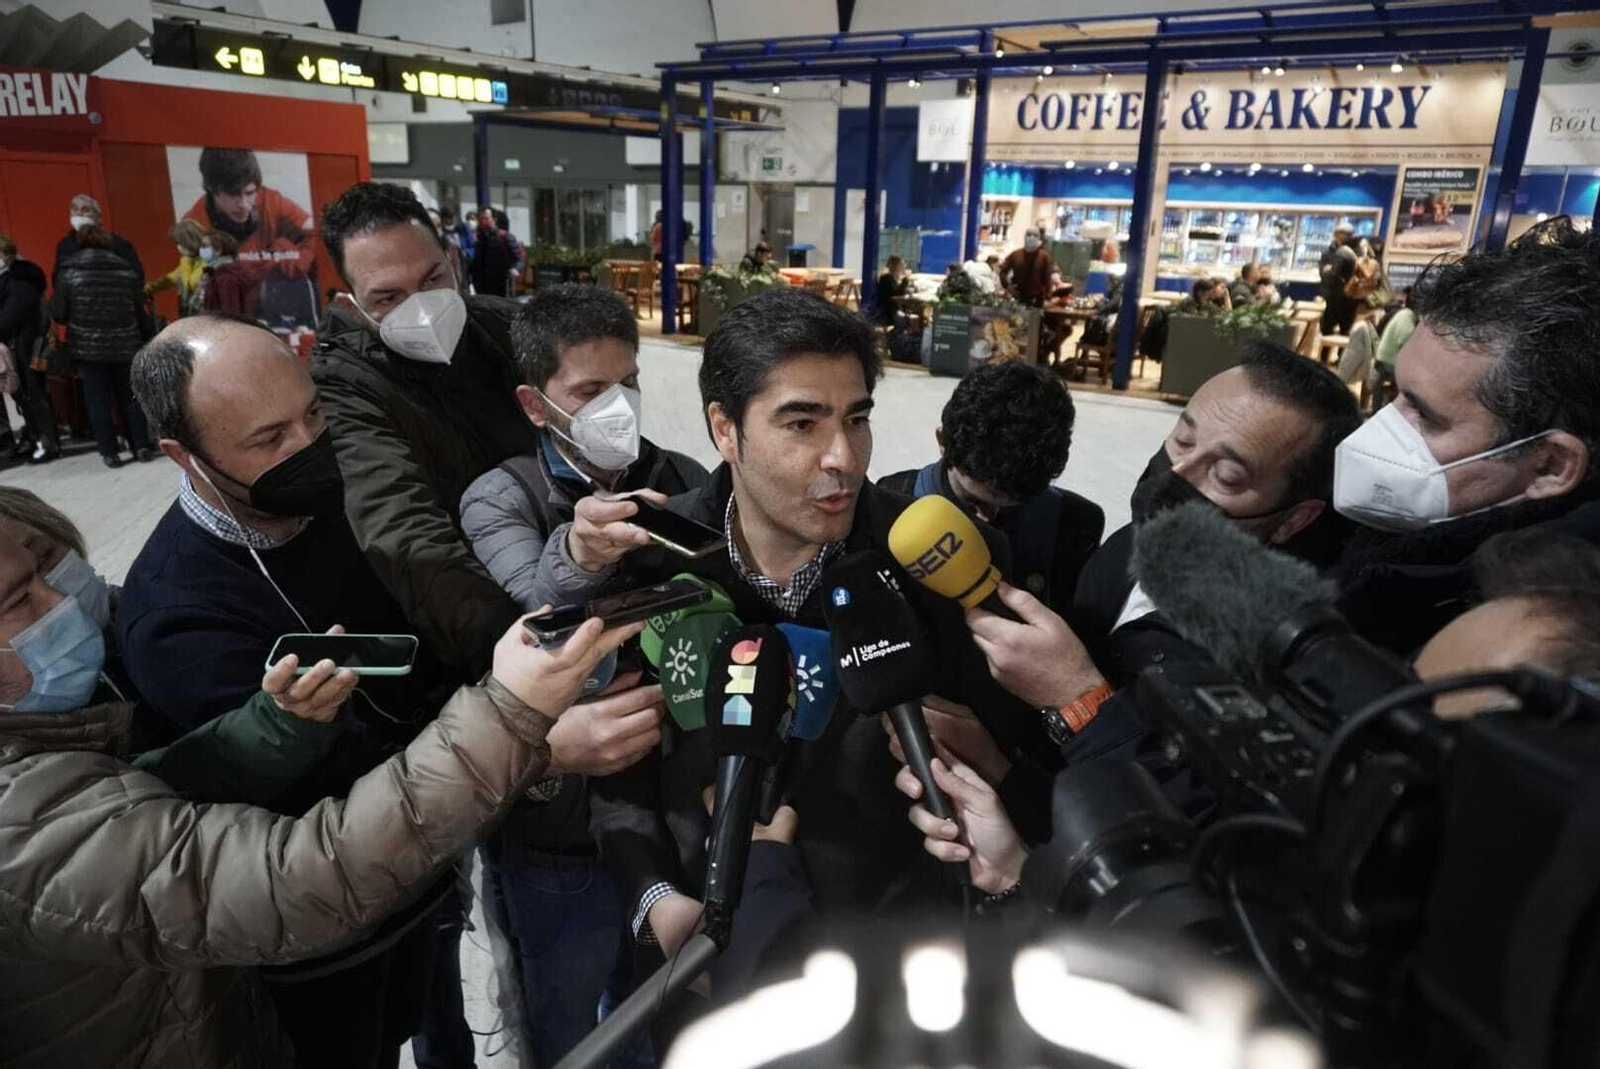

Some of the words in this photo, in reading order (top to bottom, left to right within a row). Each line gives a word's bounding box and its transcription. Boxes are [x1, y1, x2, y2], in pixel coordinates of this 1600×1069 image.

[0, 73, 88, 116] RELAY
[1182, 89, 1211, 130] &
[1225, 86, 1432, 130] BAKERY
[859, 644, 877, 655] Liga
[878, 639, 889, 648] de
[862, 641, 911, 661] Campeones
